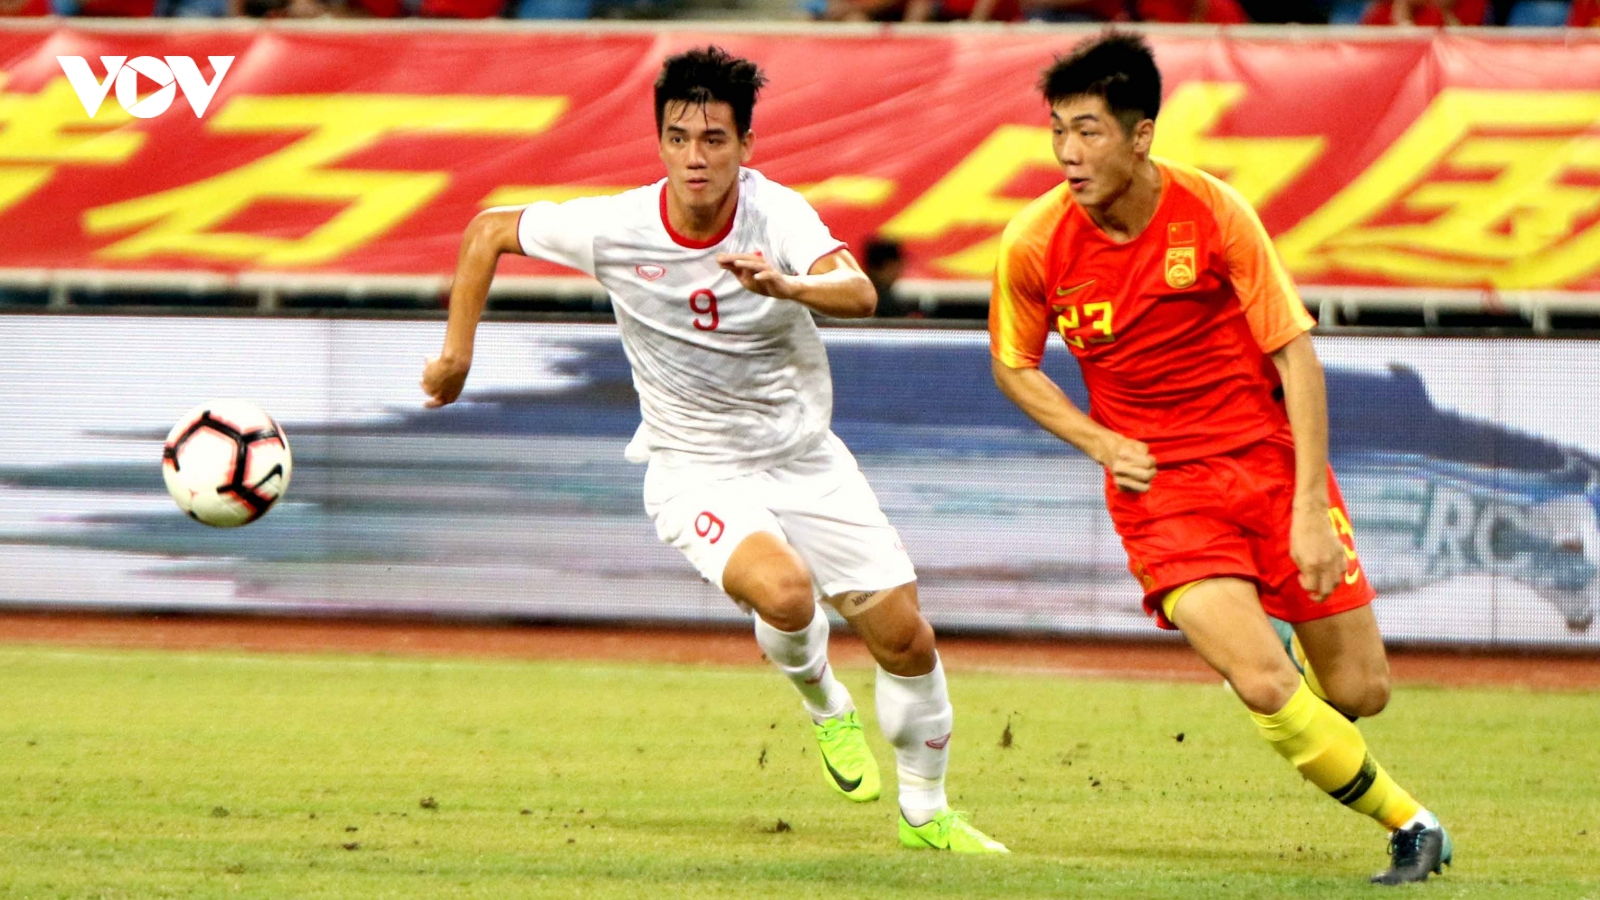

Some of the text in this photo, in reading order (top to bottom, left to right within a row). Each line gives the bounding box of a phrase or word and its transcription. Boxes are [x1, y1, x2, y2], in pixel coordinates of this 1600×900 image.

[690, 288, 719, 331] 9
[1053, 301, 1116, 349] 23
[694, 511, 725, 544] 9
